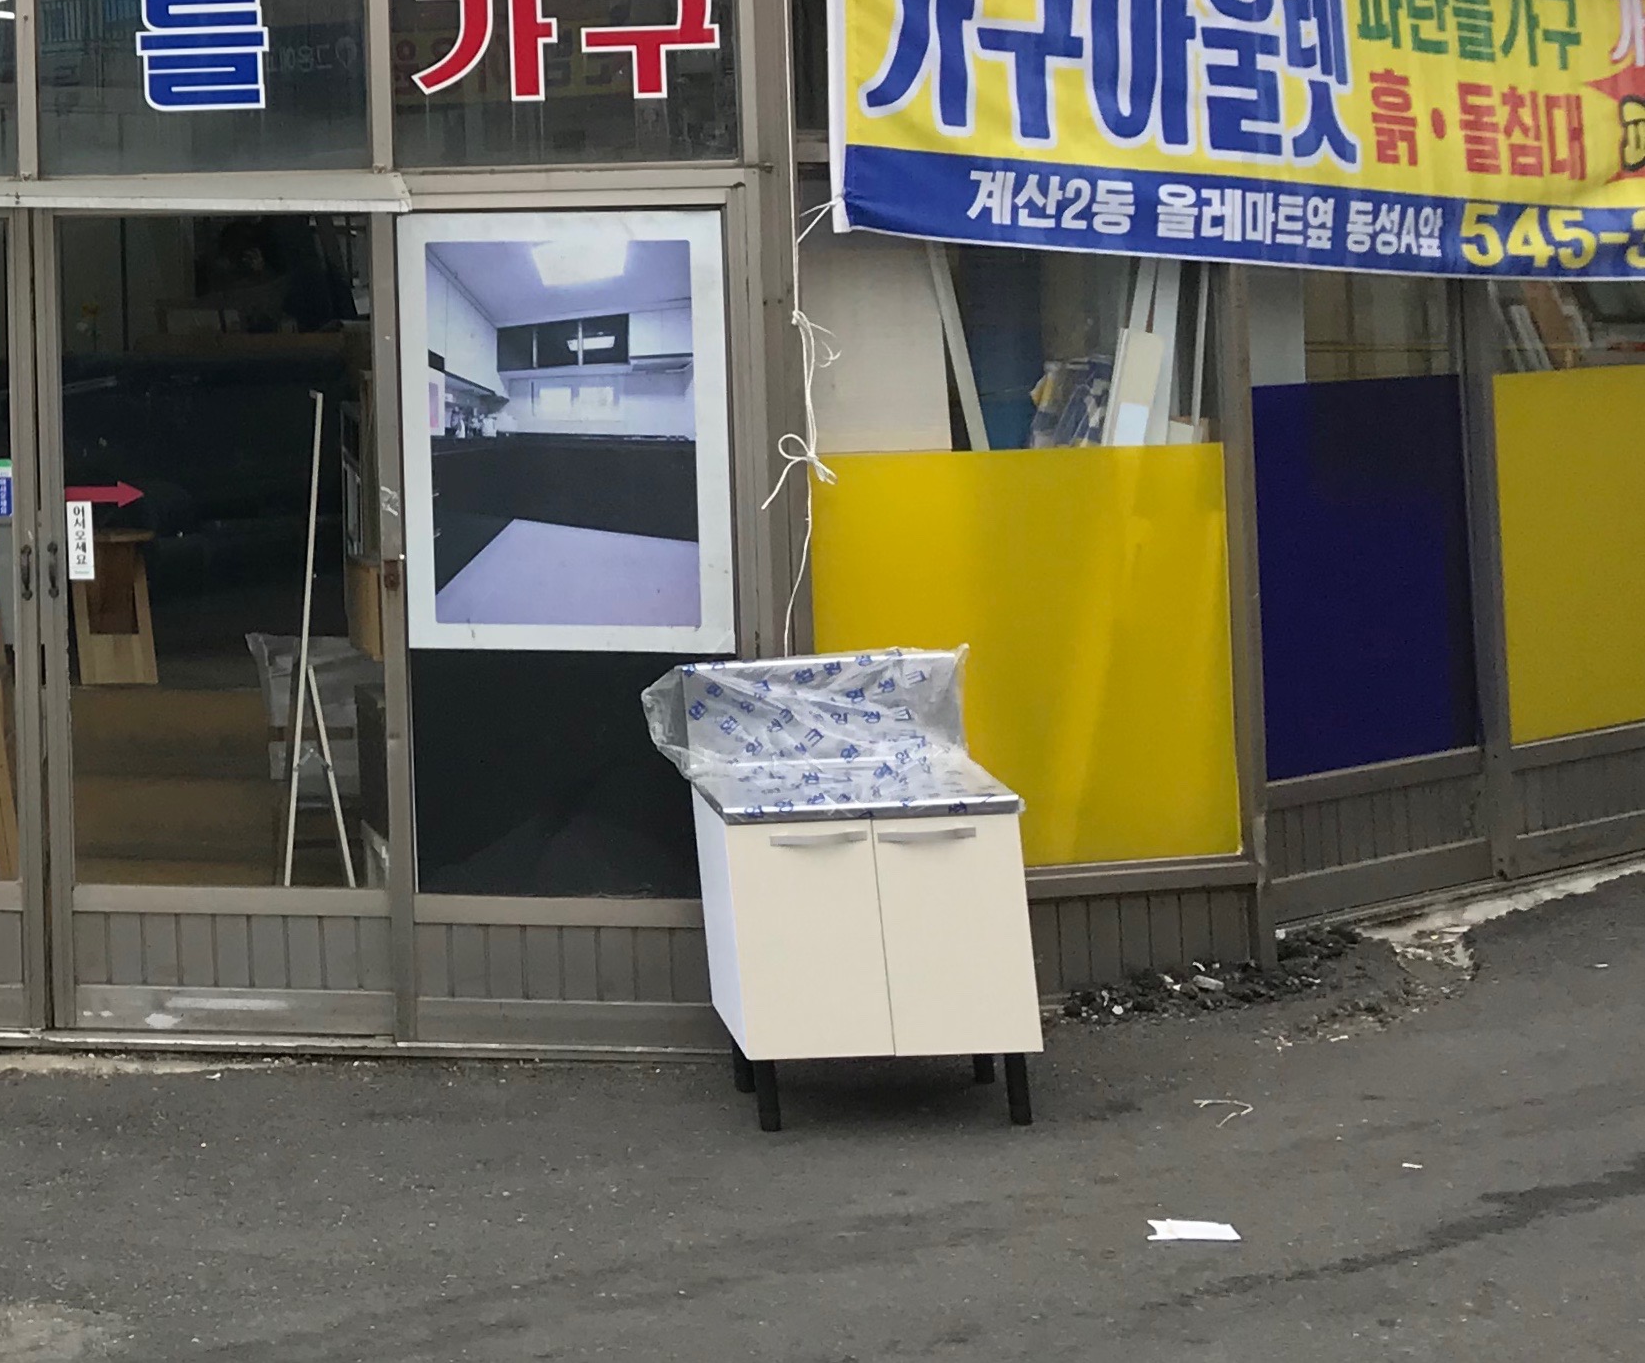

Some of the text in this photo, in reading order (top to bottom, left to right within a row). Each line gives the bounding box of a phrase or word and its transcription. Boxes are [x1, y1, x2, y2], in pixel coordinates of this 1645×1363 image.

[966, 169, 1136, 235] 계산2동
[1156, 183, 1335, 249] 올레마트옆
[1345, 201, 1444, 257] 동성A앞
[73, 505, 88, 565] 어서오세요
